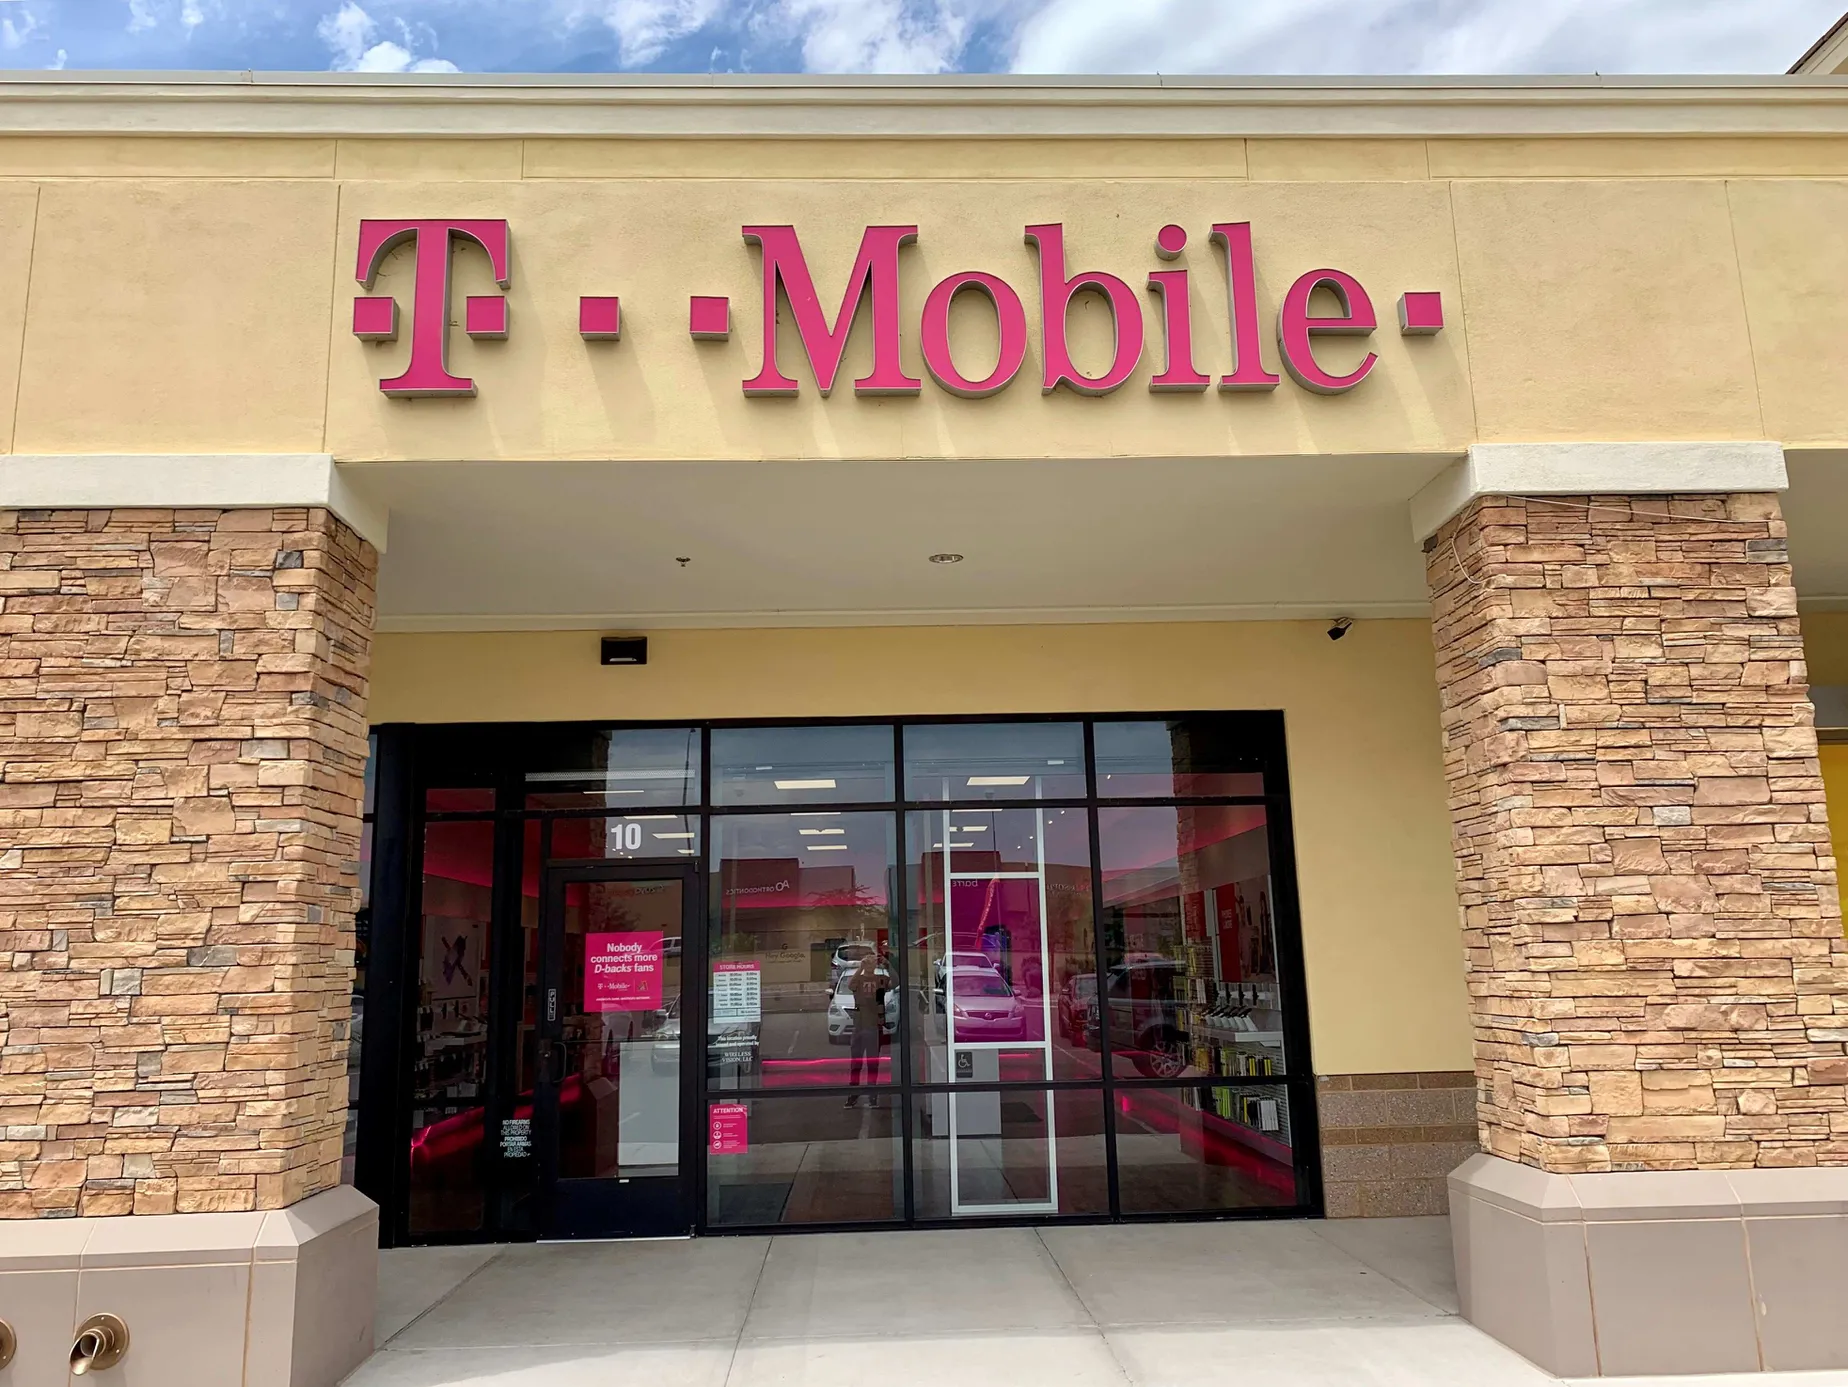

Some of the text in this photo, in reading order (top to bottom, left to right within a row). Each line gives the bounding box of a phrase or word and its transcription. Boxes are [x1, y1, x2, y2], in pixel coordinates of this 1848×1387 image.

[611, 823, 642, 850] 10
[607, 942, 642, 954] Nobody
[591, 954, 658, 963] connects more
[594, 963, 654, 974] D-backs fans
